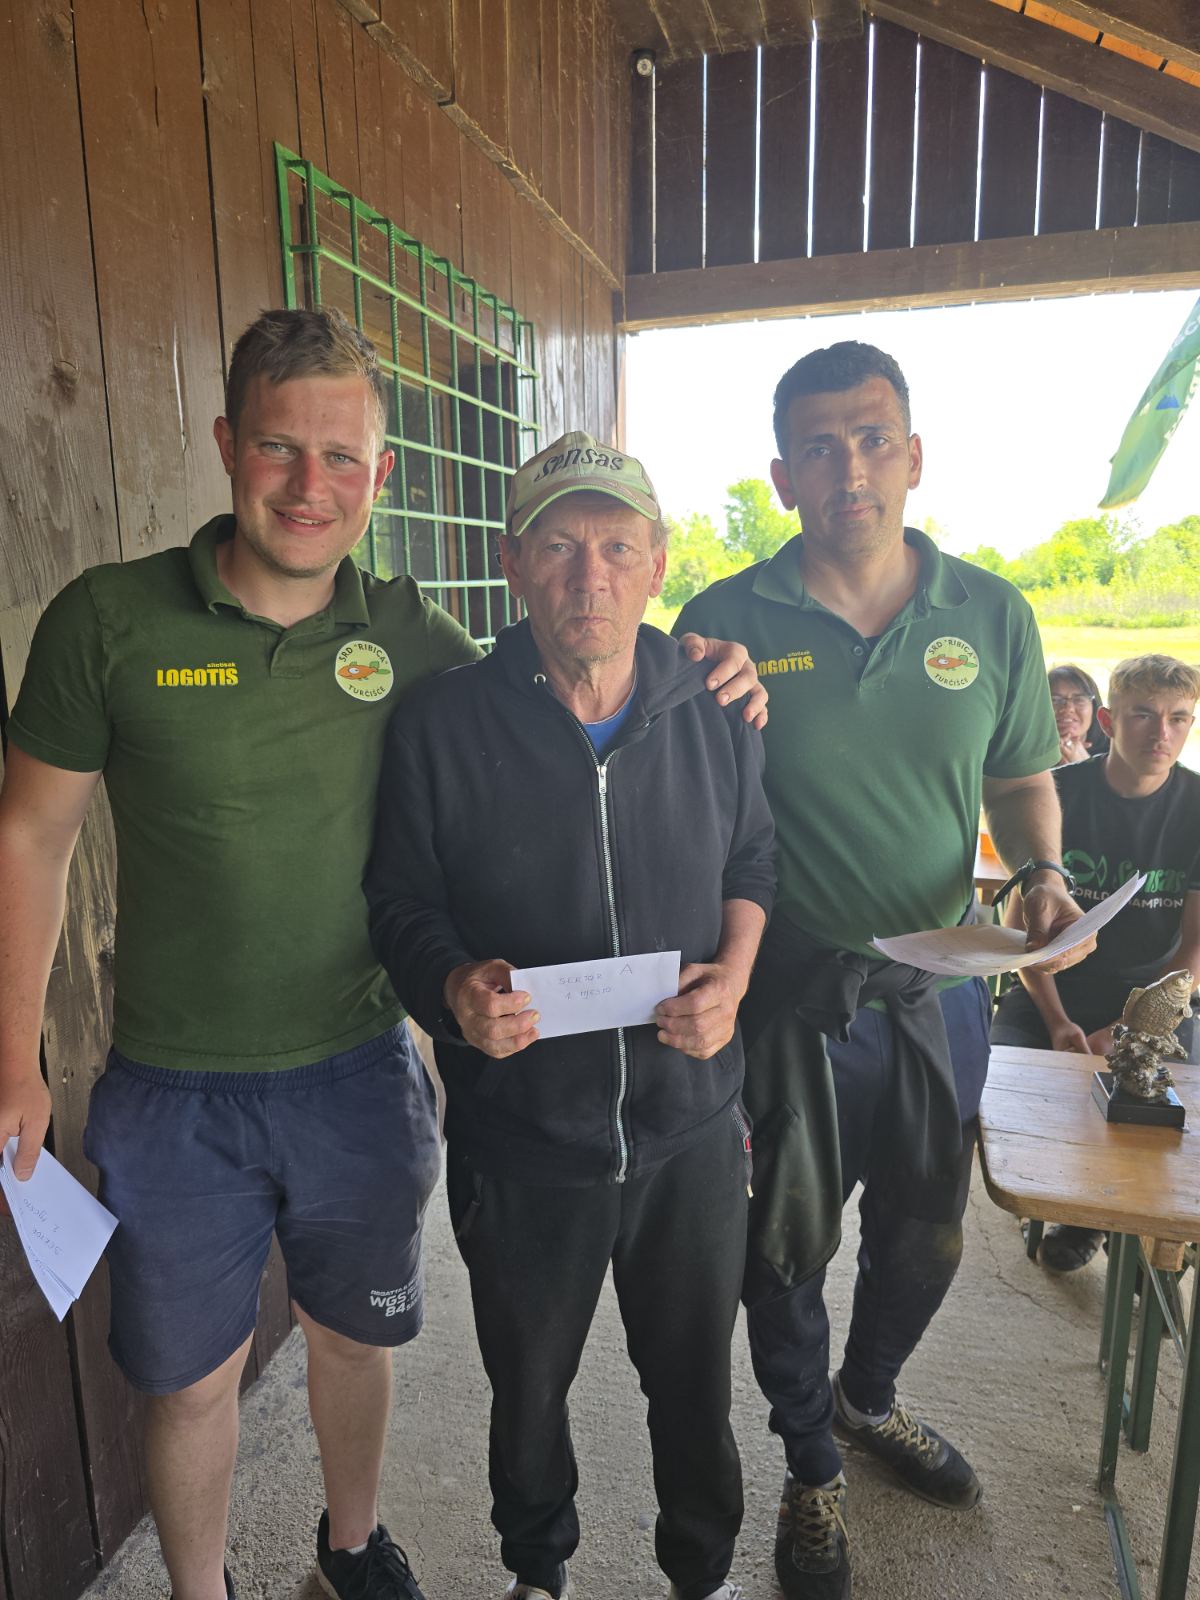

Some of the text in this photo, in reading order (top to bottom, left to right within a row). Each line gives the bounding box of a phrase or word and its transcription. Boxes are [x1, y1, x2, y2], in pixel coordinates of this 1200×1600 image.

[338, 646, 353, 663] SRD
[928, 641, 943, 655] SRD
[756, 655, 815, 677] OGOTIS
[156, 669, 238, 687] LOGOTIS
[1075, 887, 1184, 909] ORLD AMPION
[619, 963, 633, 976] A
[369, 1291, 407, 1308] WGS
[385, 1302, 406, 1317] 84
